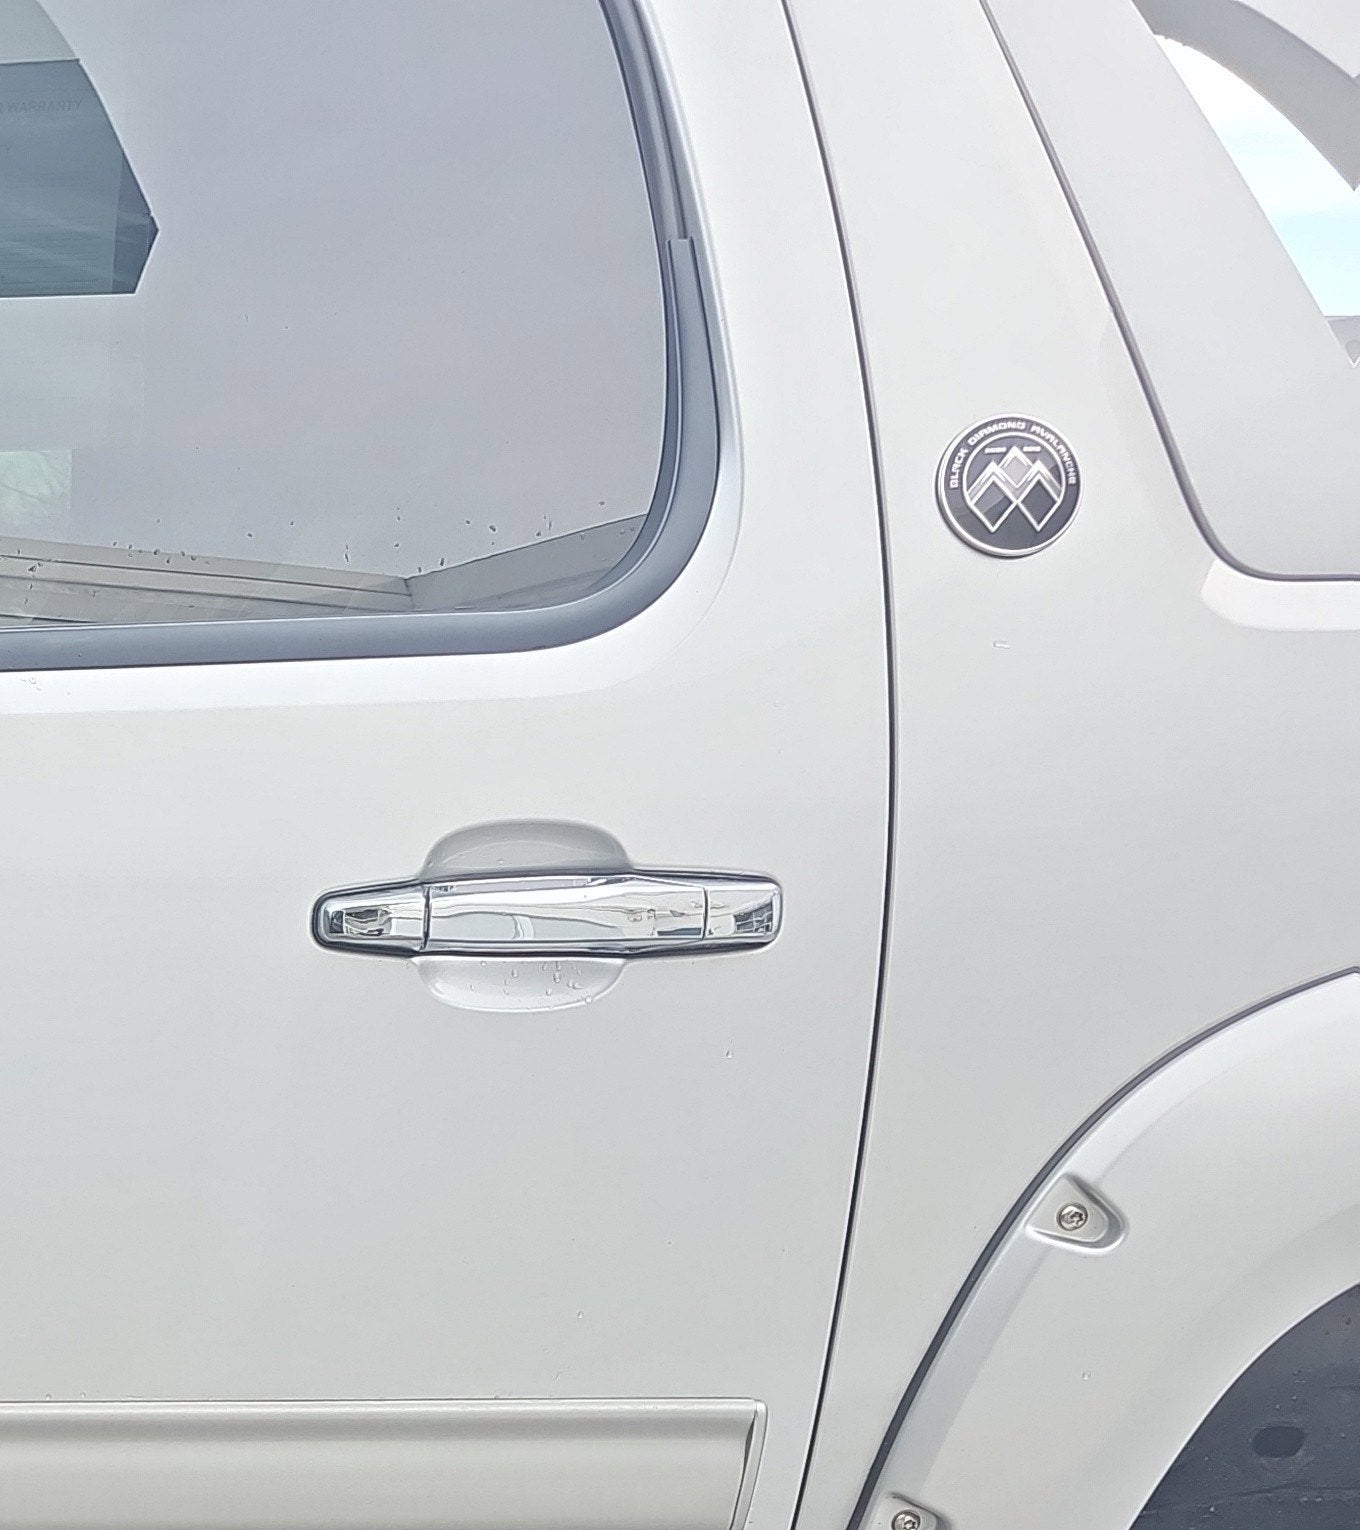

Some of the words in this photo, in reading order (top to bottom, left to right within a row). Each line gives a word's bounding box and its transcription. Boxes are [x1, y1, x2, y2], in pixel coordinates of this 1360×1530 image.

[7, 100, 82, 113] WARRANTY
[949, 448, 969, 489] BLACK
[968, 420, 1026, 446] DIAMOND
[1030, 423, 1078, 486] AVALANCHE
